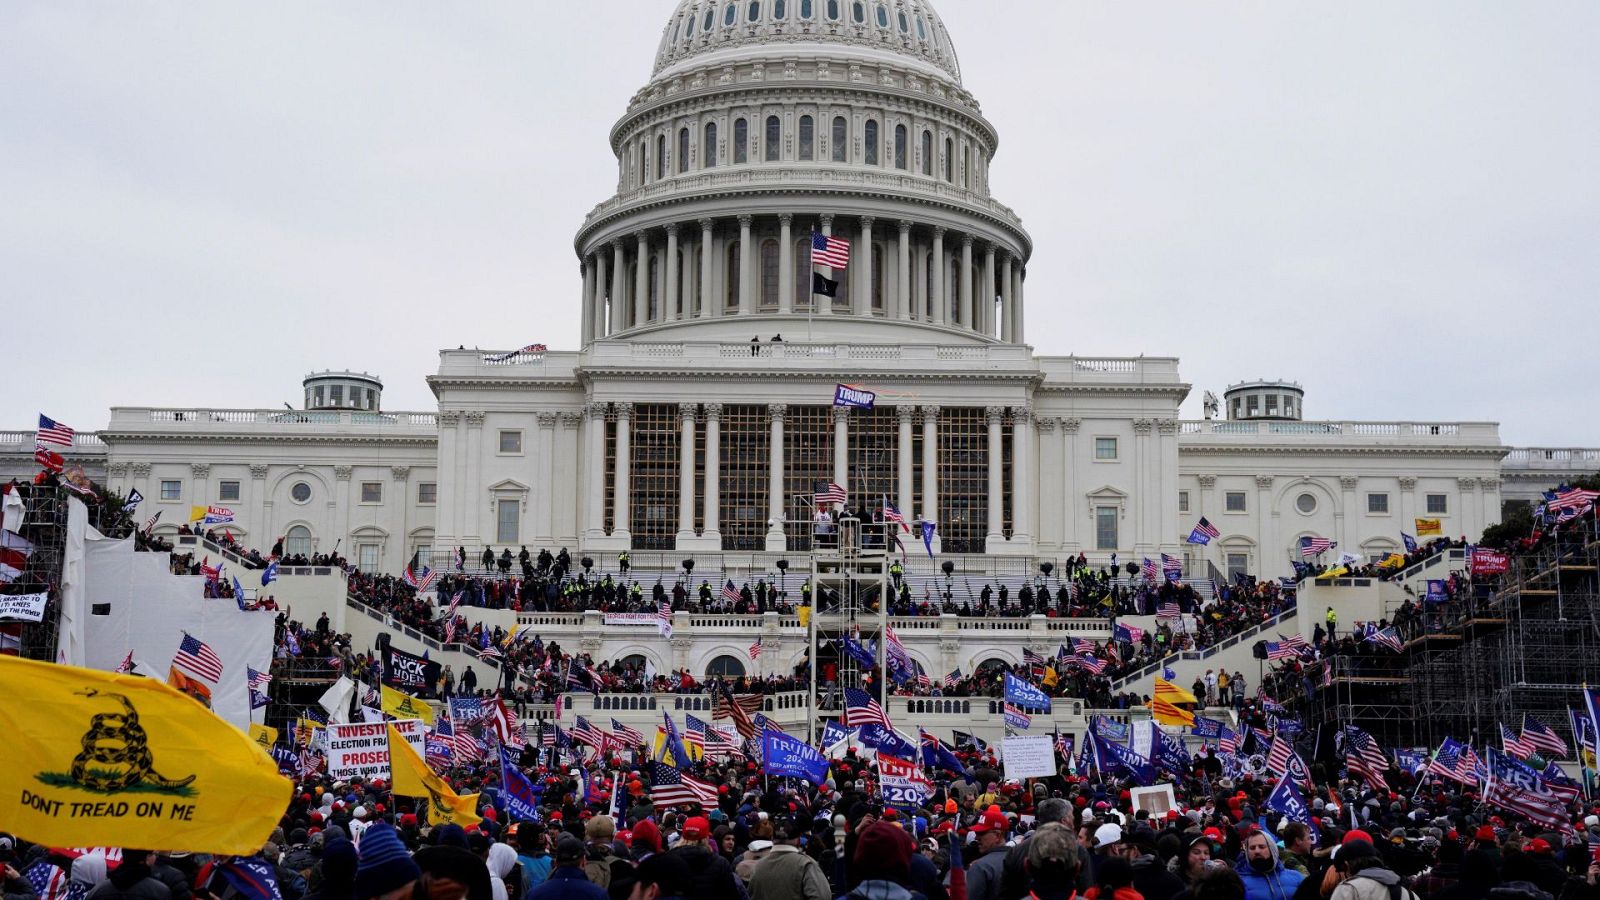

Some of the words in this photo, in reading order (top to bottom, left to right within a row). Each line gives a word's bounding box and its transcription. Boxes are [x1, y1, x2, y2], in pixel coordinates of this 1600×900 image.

[839, 386, 873, 404] TRUMP
[1475, 555, 1505, 564] TRUMP
[21, 609, 40, 617] POWER
[391, 653, 427, 675] FUCK
[1014, 689, 1044, 701] 2024
[457, 708, 487, 719] TRU
[337, 721, 415, 738] INVESTIATE
[331, 739, 370, 749] ELECTION
[373, 737, 387, 746] FRA
[606, 738, 625, 749] TRU
[342, 751, 389, 765] PROSEC
[332, 768, 358, 776] THOSE
[360, 766, 378, 775] WHO
[21, 789, 64, 817] DONT
[70, 802, 129, 817] TREAD
[135, 802, 163, 818] ON
[170, 803, 196, 821] ME
